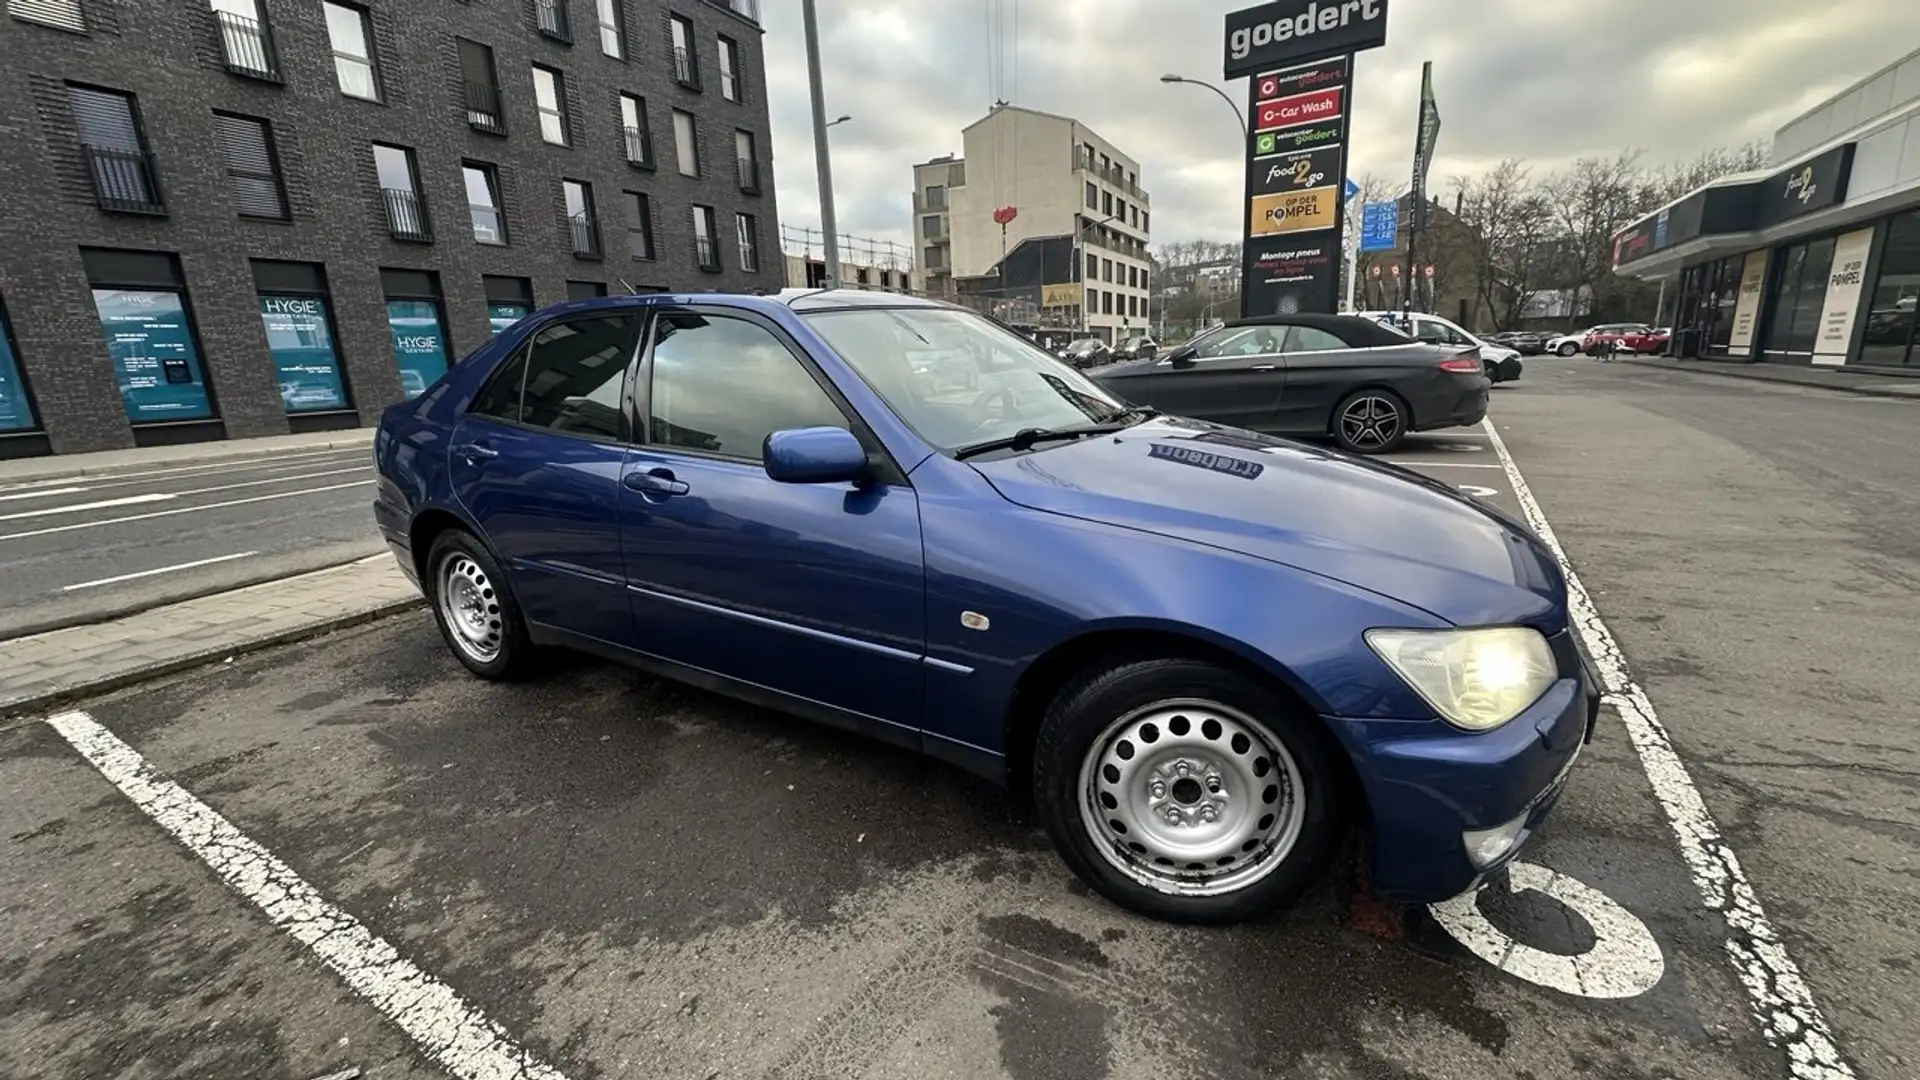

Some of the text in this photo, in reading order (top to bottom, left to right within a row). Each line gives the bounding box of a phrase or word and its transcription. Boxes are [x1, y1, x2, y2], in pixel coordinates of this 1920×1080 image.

[1231, 0, 1380, 59] goedert
[1301, 98, 1333, 114] Wash
[1295, 129, 1337, 145] goedert
[1285, 196, 1317, 206] OP DER
[1266, 205, 1321, 222] POMPEL
[266, 300, 318, 314] HYGIE
[398, 336, 438, 349] HYGIE
